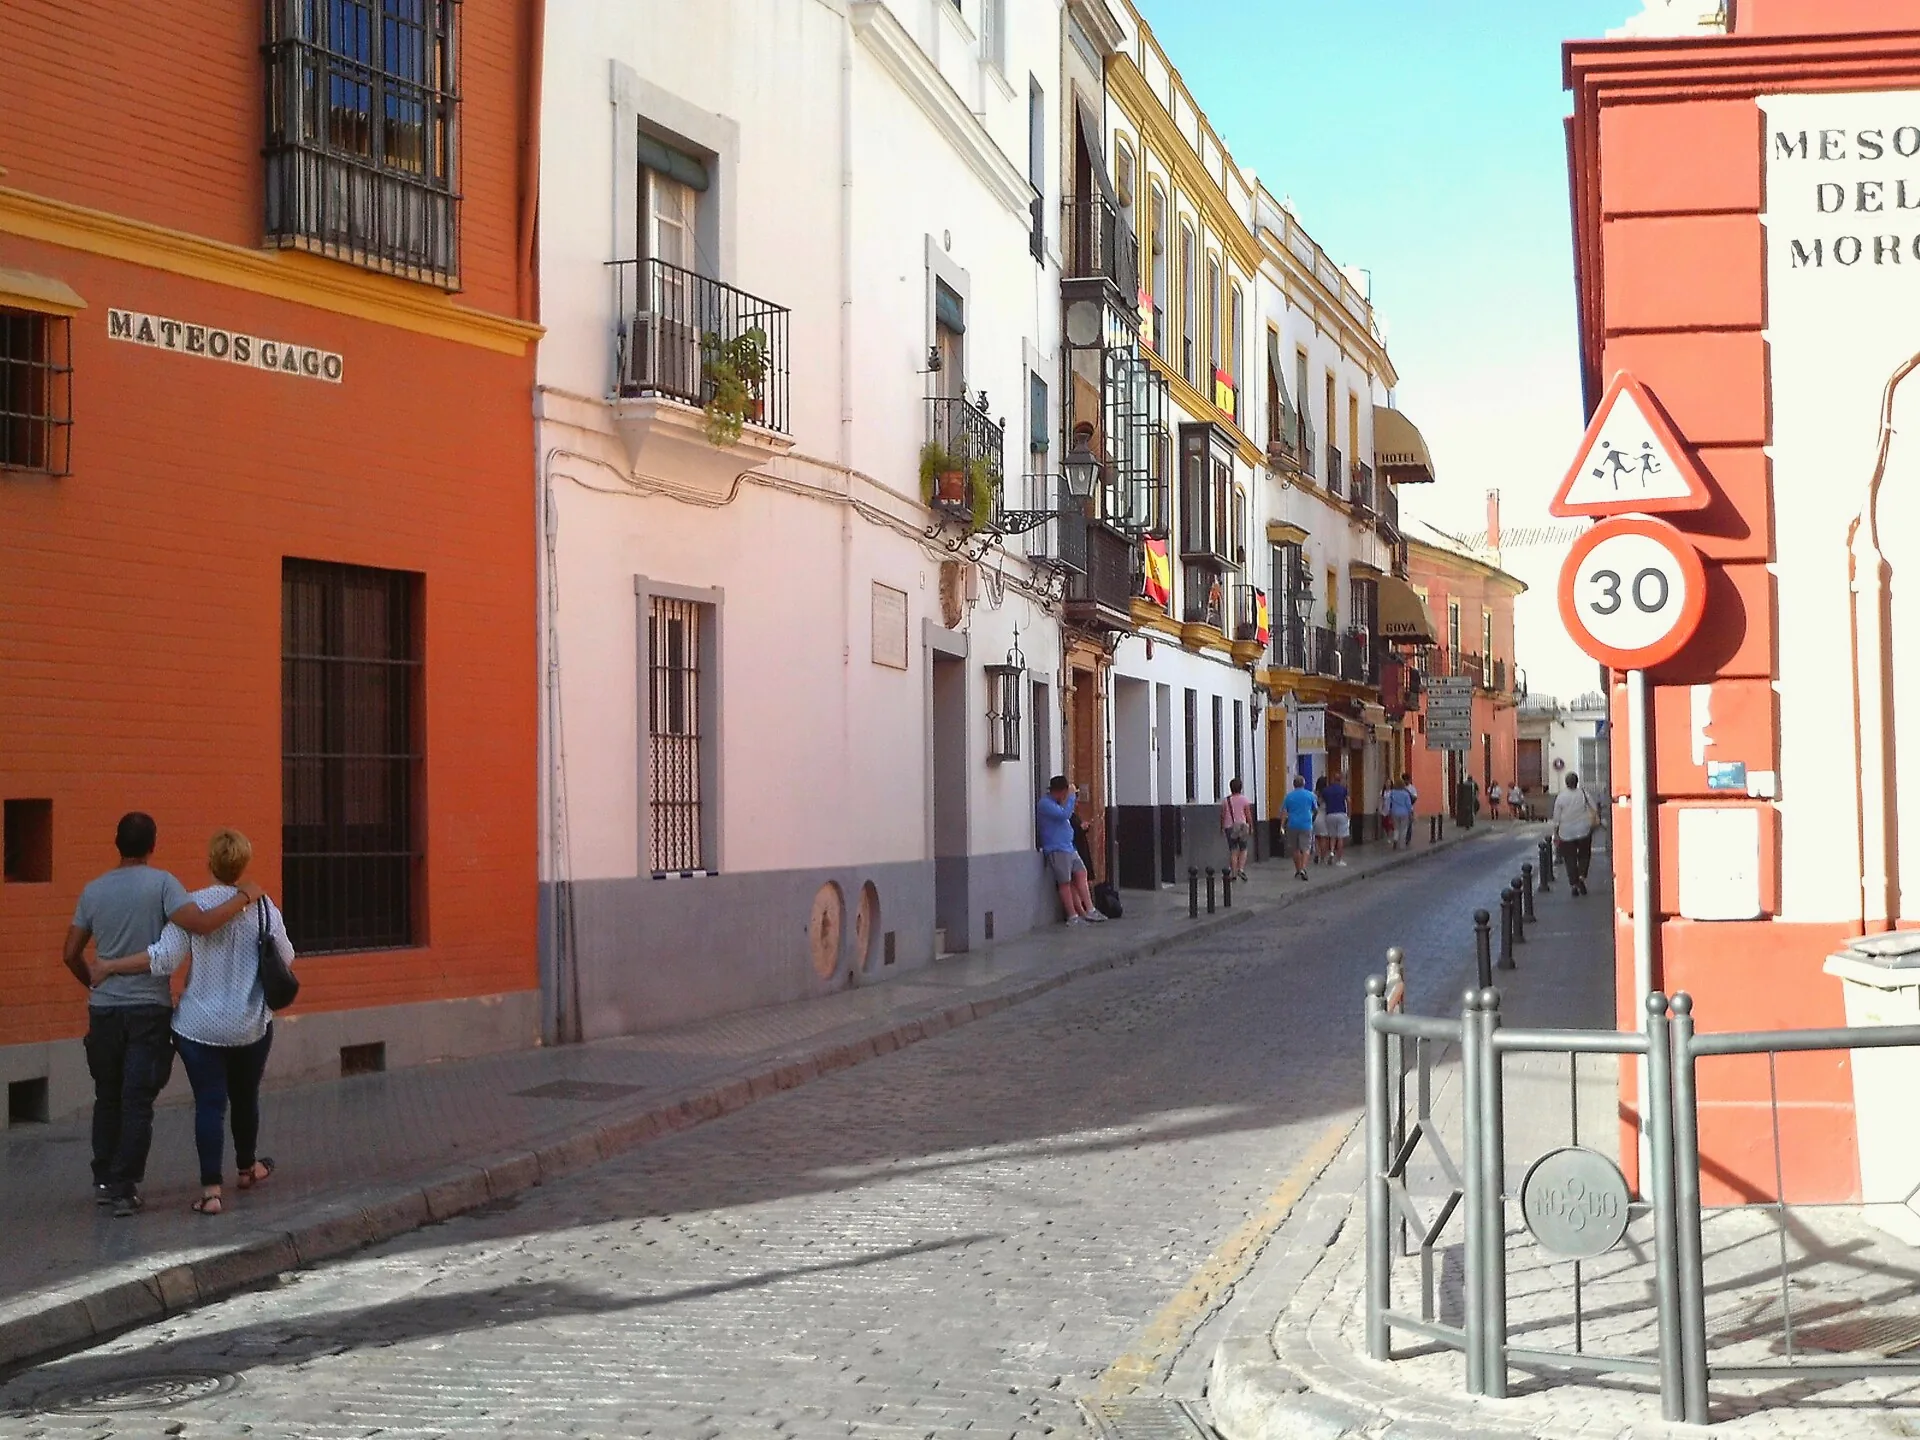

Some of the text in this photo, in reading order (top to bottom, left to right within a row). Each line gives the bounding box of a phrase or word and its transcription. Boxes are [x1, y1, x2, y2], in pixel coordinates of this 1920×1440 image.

[1816, 179, 1920, 214] DEL
[109, 310, 342, 380] MATEOS GAGO
[1381, 453, 1415, 463] HOTEL
[1590, 567, 1669, 615] 30
